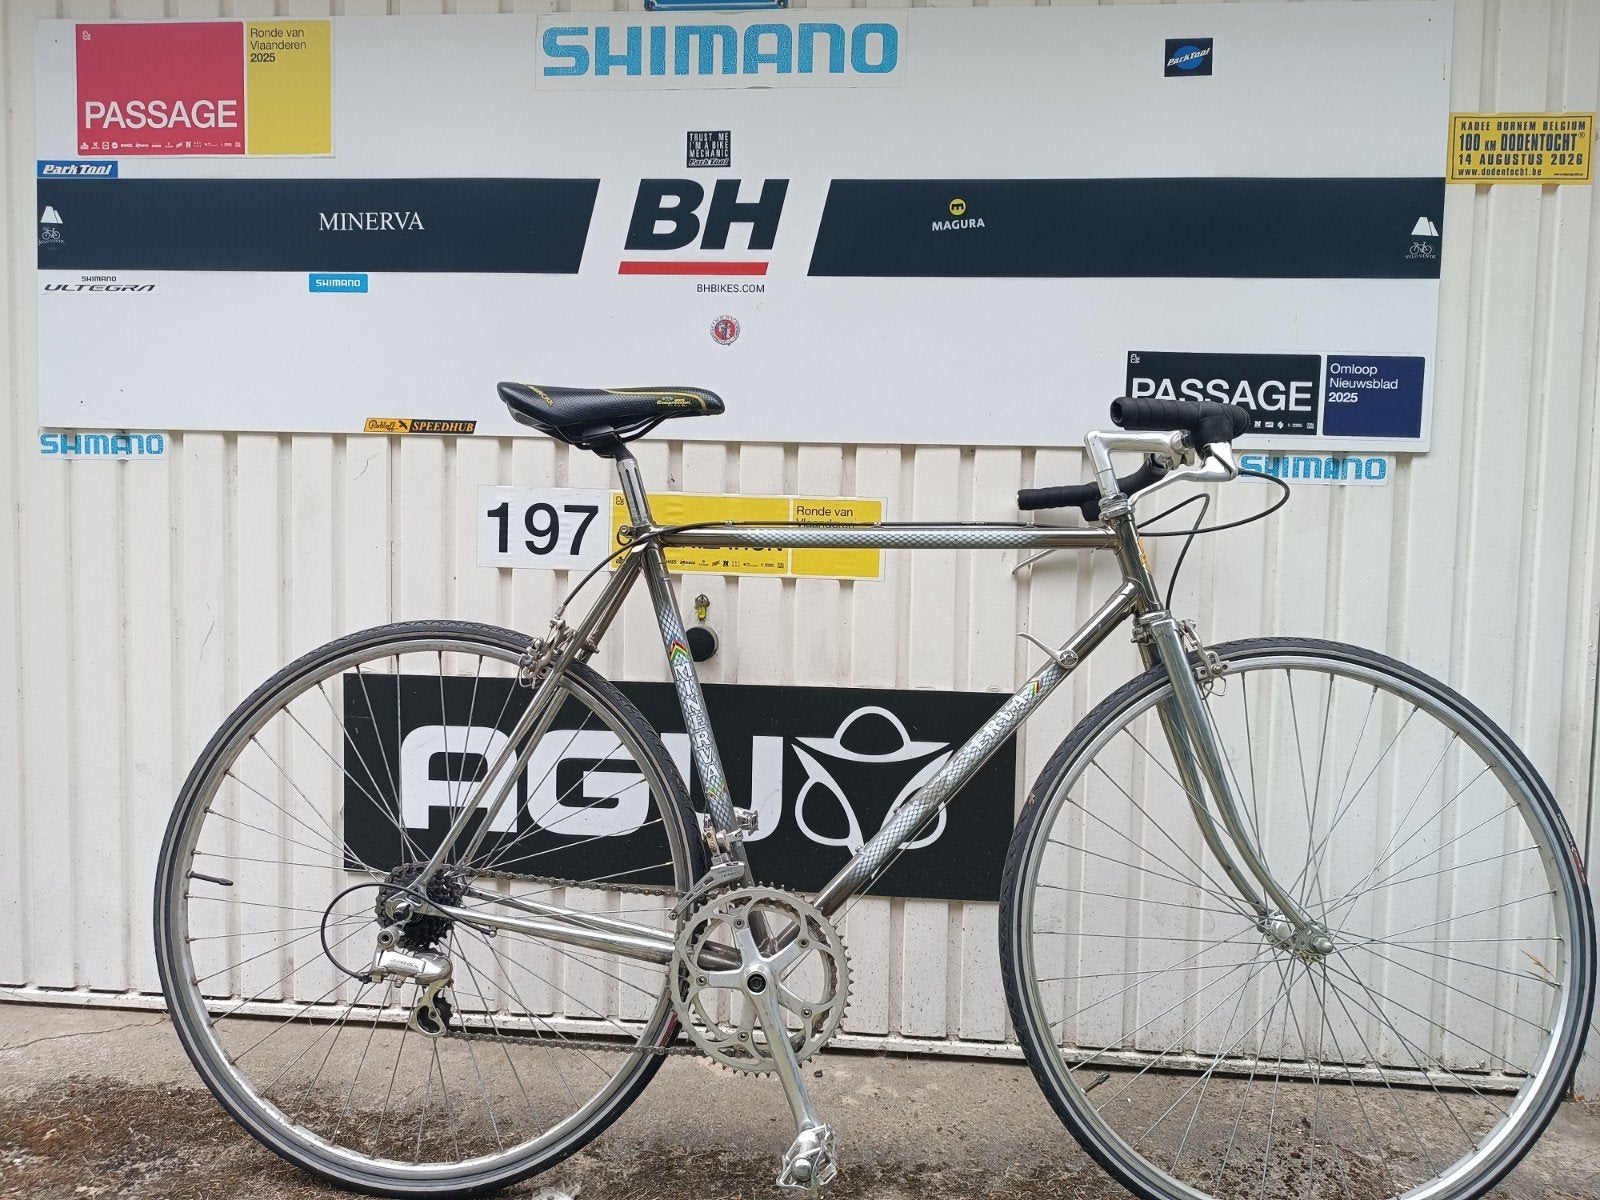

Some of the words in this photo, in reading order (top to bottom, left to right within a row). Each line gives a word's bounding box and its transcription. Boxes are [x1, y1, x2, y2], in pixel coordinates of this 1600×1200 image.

[250, 28, 283, 38] Ronde
[286, 29, 305, 37] van
[250, 40, 307, 50] Vlaanderen
[542, 23, 898, 76] SHIMANO
[250, 52, 276, 62] 2025
[84, 100, 238, 129] PASSAGE
[1461, 121, 1490, 130] KADEE
[1497, 121, 1536, 130] BORNEM
[1543, 121, 1586, 130] BELGIUM
[690, 132, 712, 141] TRUST
[718, 132, 729, 141] ME
[1459, 133, 1480, 151] 100
[1485, 140, 1496, 151] KM
[690, 141, 701, 149] I'M
[704, 141, 709, 149] A
[712, 141, 729, 149] BIKE
[689, 149, 729, 158] MECHANIC
[1458, 153, 1471, 165] 14
[1479, 153, 1543, 165] AUGUSTUS
[1551, 153, 1583, 165] 2026
[1458, 167, 1541, 176] www.dodentocht.be
[624, 178, 790, 250] BH
[318, 211, 425, 231] MINERVA
[932, 218, 986, 231] MAGURA
[44, 283, 156, 292] ULTEGRA
[315, 278, 361, 288] SHIMANO
[696, 283, 765, 293] BHBIKES.COM
[1330, 363, 1378, 377] Omloop
[1329, 377, 1399, 390] Nieuwsblad
[1131, 377, 1313, 412] PASSAGE
[1328, 392, 1359, 403] 2025
[412, 421, 474, 432] SPEEDHUB
[1239, 455, 1387, 480] SHIMANO
[796, 506, 831, 516] Ronde
[834, 508, 853, 516] van
[487, 501, 599, 556] 197
[673, 664, 721, 781] MINERVA
[401, 725, 783, 843] AGU
